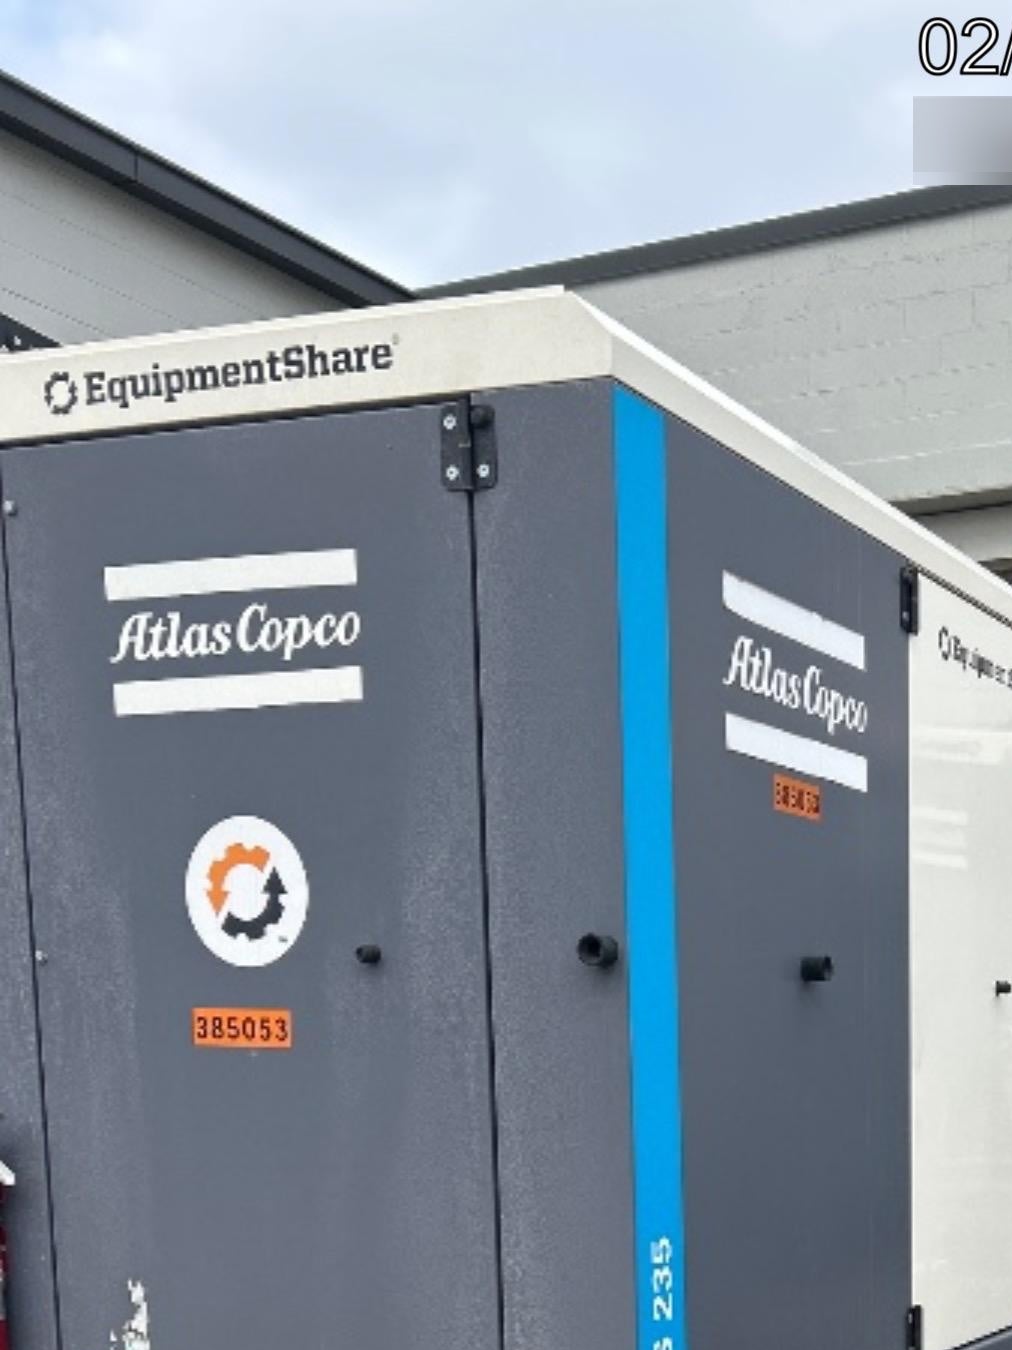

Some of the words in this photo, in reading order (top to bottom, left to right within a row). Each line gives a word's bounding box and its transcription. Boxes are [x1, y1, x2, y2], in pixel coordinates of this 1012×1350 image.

[83, 343, 394, 408] EquipmentShare
[109, 610, 232, 664] Atlas
[236, 602, 361, 661] Copco
[722, 635, 801, 709] Atlas
[803, 665, 868, 736] Copco
[196, 1015, 289, 1042] 385053
[650, 1235, 674, 1322] 235
